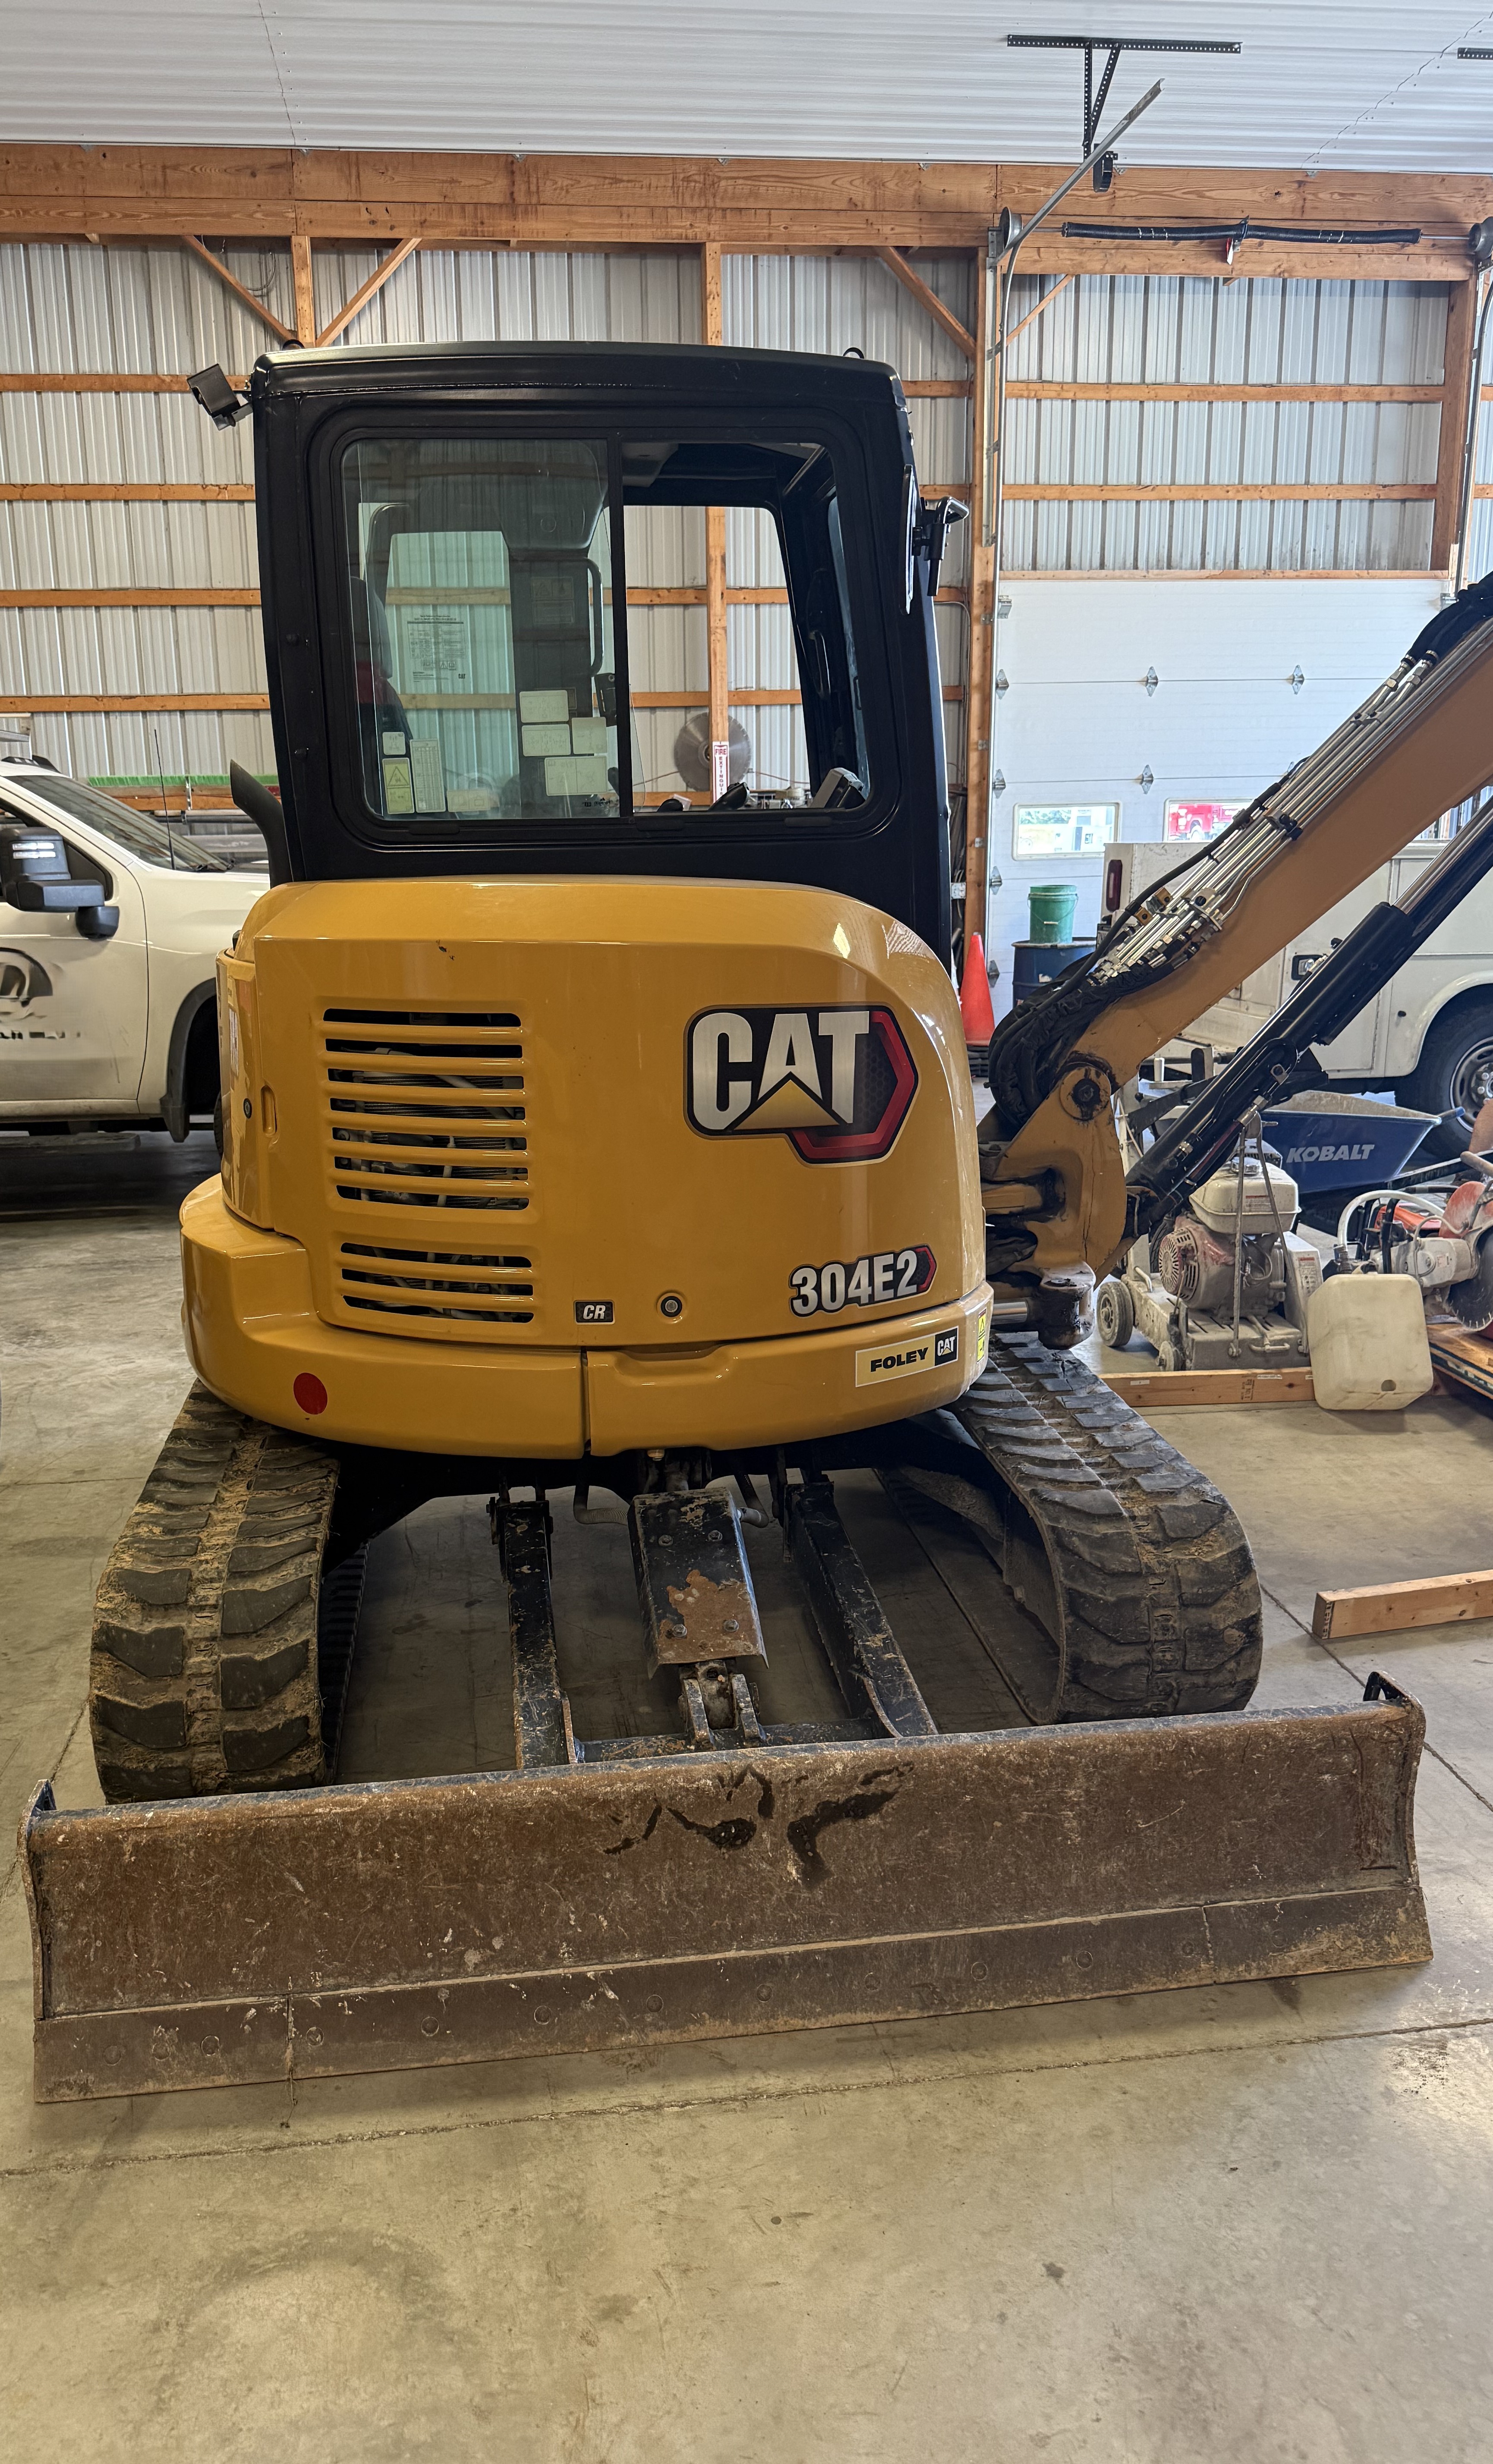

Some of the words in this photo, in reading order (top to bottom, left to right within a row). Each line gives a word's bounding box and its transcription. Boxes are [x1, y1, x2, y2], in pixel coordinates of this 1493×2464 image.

[693, 1011, 869, 1130] CAT
[1286, 1144, 1375, 1163] KOBALT
[792, 1250, 917, 1314] 304E2
[583, 1305, 606, 1320] CR
[870, 1347, 929, 1372] FOLEY
[937, 1336, 955, 1356] CAT
